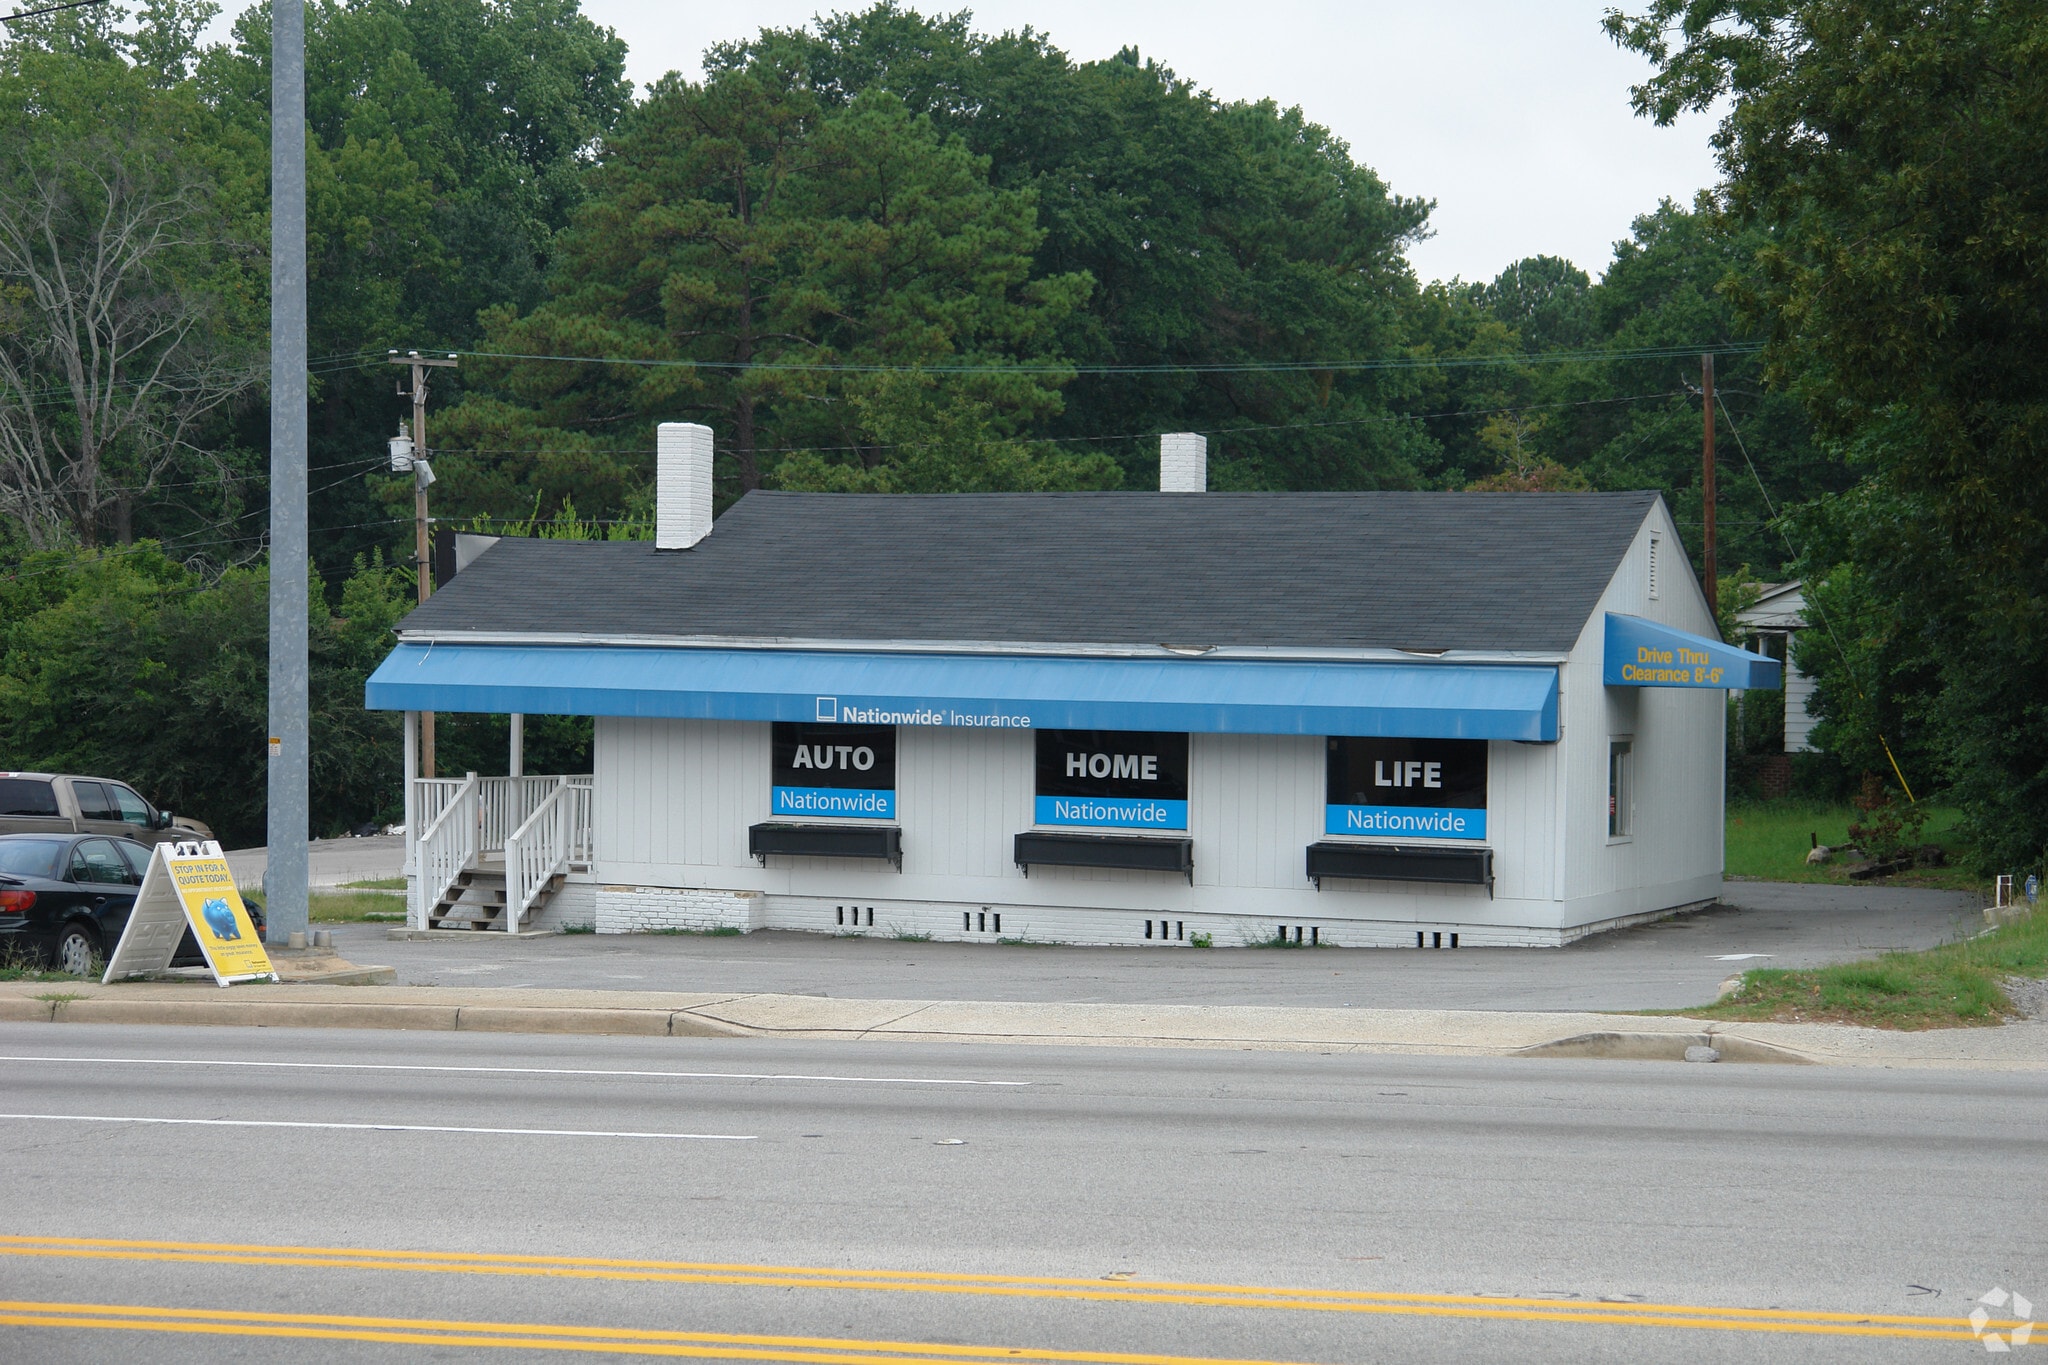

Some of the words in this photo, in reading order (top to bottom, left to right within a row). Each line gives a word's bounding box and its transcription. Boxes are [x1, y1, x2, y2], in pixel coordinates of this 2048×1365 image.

[1637, 647, 1673, 664] Drive
[1677, 648, 1709, 665] Thru
[1622, 664, 1690, 683] Clearance
[951, 709, 1031, 728] Insurance
[792, 744, 875, 771] AUTO
[1066, 752, 1158, 780] HOME
[1375, 760, 1442, 788] LIFE
[781, 790, 888, 813] Nationwide
[1055, 800, 1167, 823] Nationwide
[1347, 809, 1466, 832] Nationwide
[174, 865, 194, 874] STOP
[194, 864, 204, 873] IN
[204, 863, 219, 872] FOR
[219, 863, 227, 871] A
[178, 875, 205, 885] QUOTE
[205, 874, 231, 883] TODAY.
